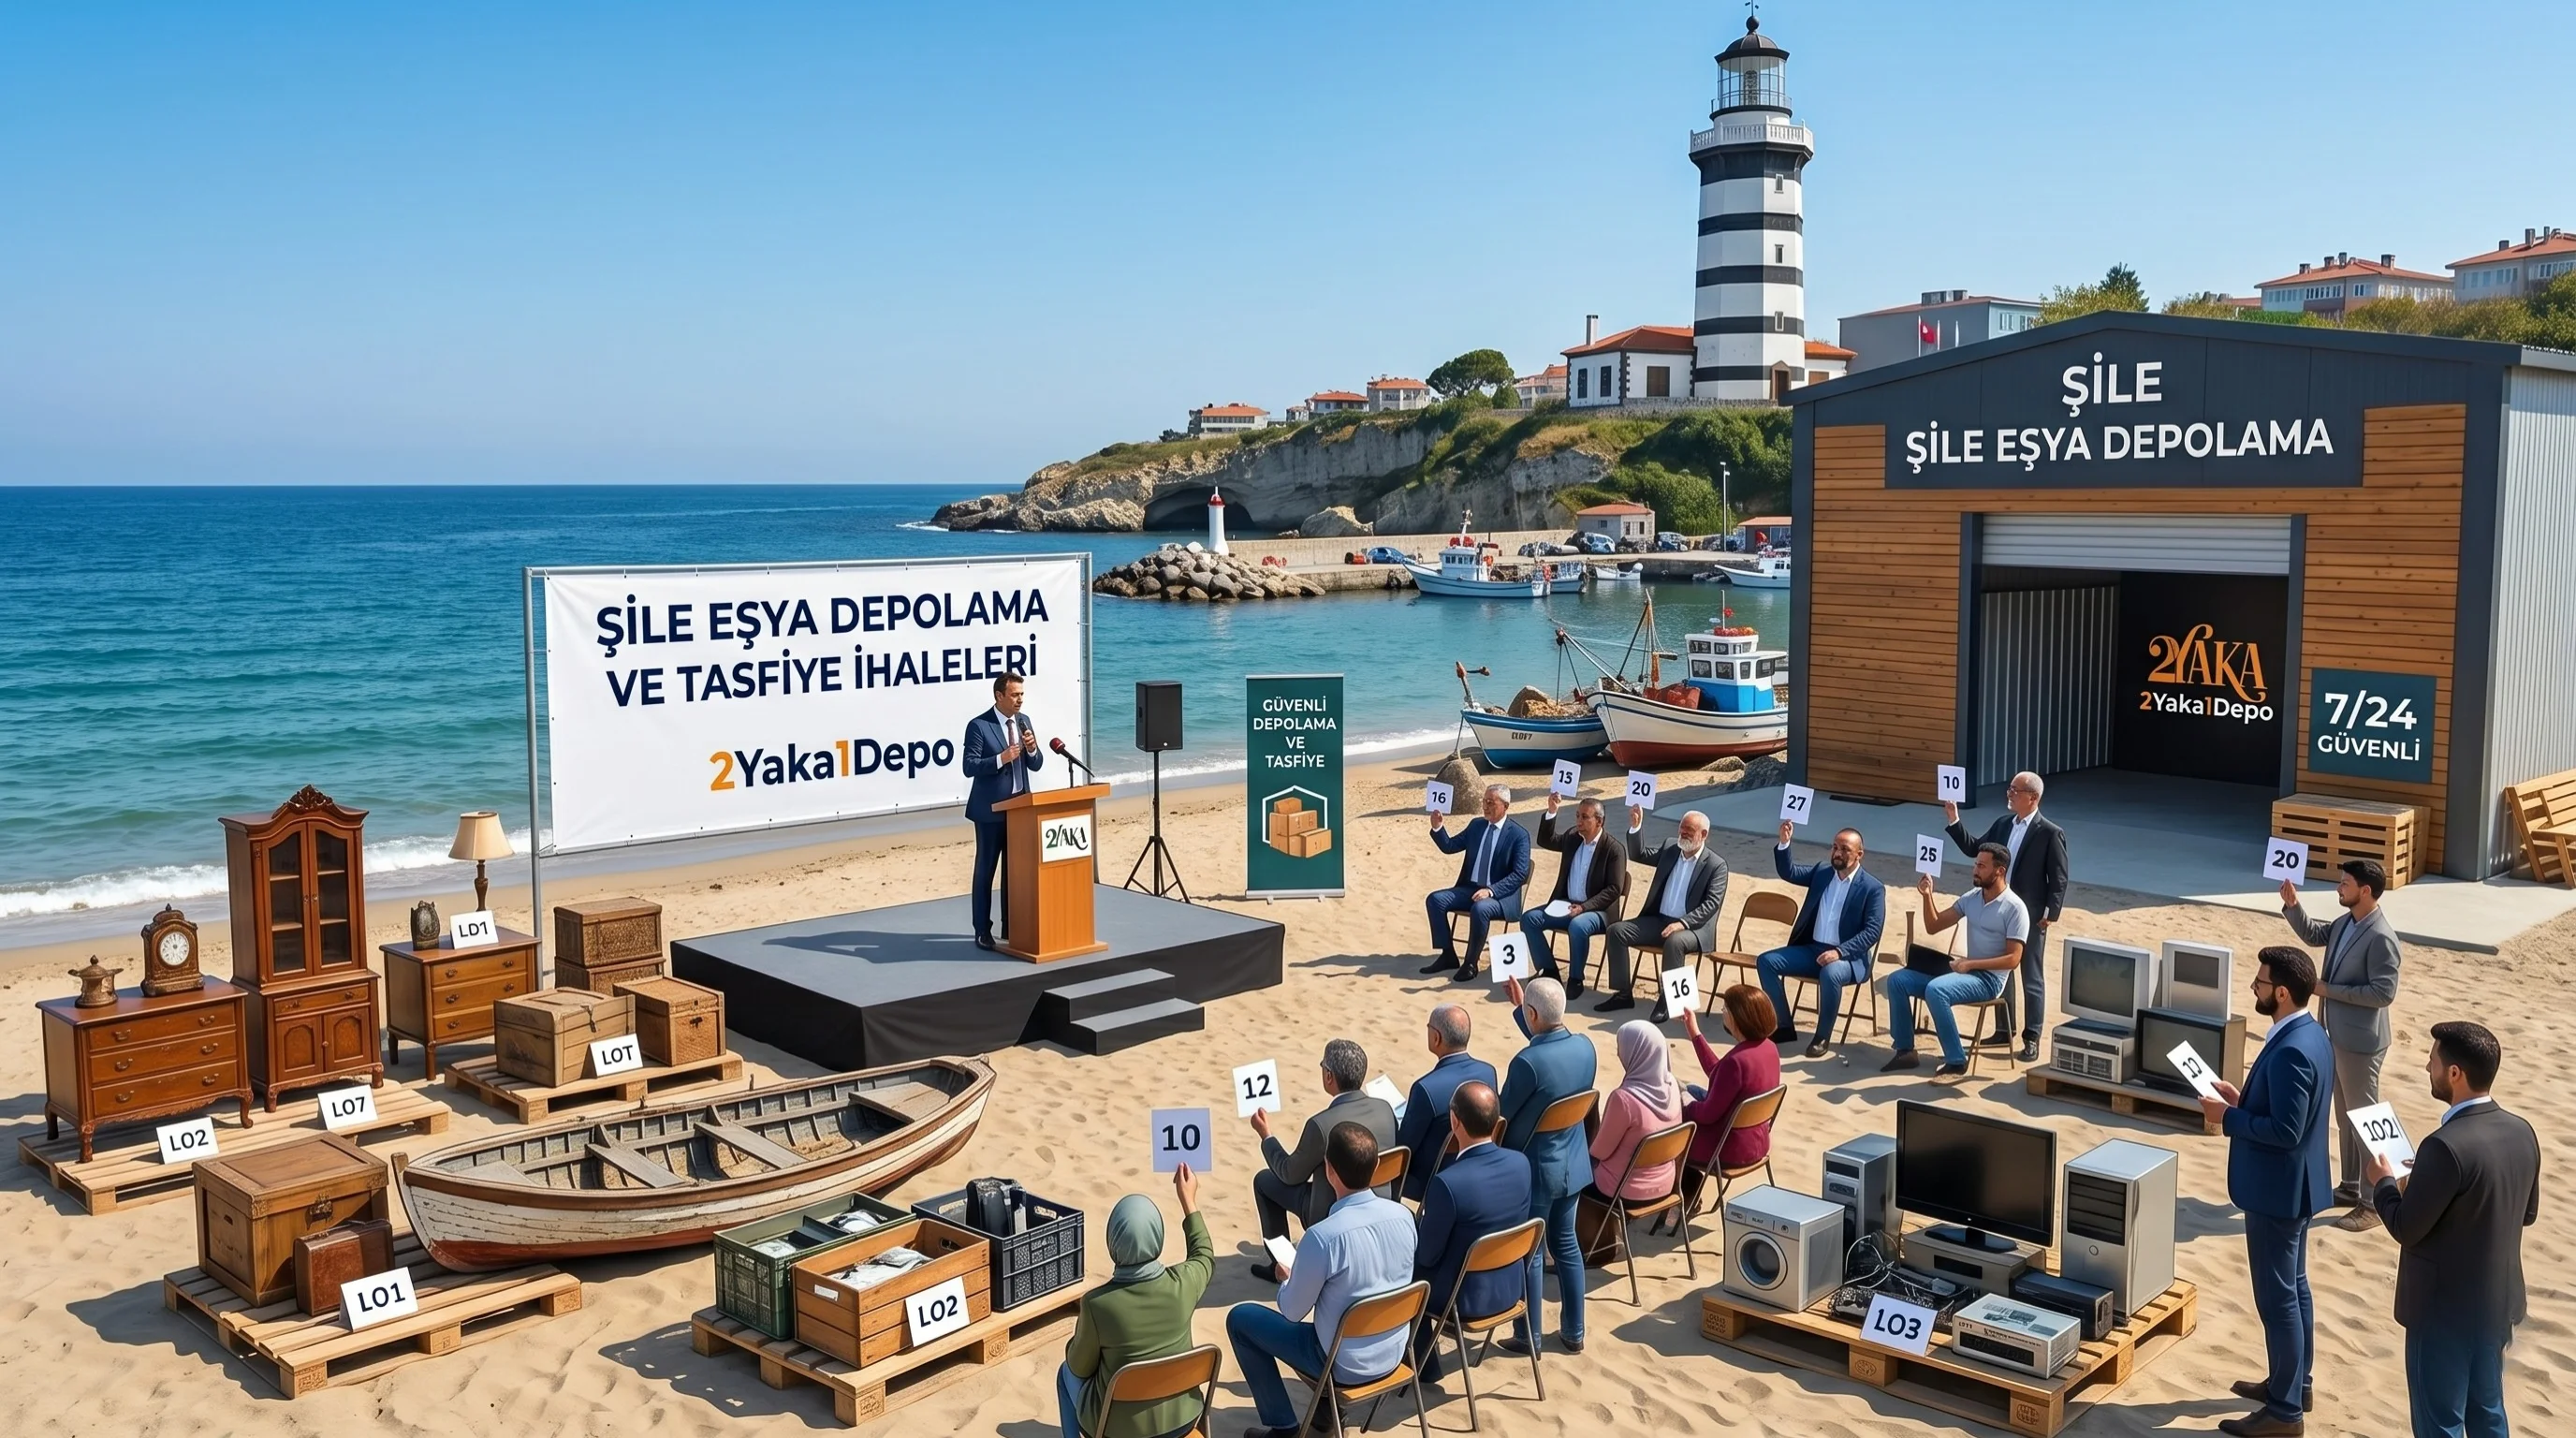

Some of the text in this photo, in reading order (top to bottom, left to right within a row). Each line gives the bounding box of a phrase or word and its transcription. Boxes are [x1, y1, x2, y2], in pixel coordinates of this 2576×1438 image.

[2062, 352, 2161, 417] ŞİLE
[1907, 418, 2334, 474] ŞİLE EŞYA DEPOLAMA
[597, 588, 1048, 657] ŞİLE EŞYA DEPOLAMA
[607, 633, 1037, 707] VE TASFİYE İHALELERİ
[1264, 696, 1325, 712] GÜVENLİ
[2140, 691, 2274, 725] 2Yaka1Depo
[2325, 689, 2418, 730] 7/24
[1254, 718, 1336, 729] DEPOLAMA
[1285, 737, 1305, 749] VE
[2318, 731, 2420, 760] GÜVENLİ
[710, 739, 954, 790] 2Yaka1Depo
[1266, 752, 1325, 768] TASFİYE
[1632, 781, 1650, 796] 20
[1944, 776, 1959, 789] 10
[1431, 791, 1446, 804] 16
[1786, 795, 1807, 811] 27
[1919, 844, 1937, 863] 25
[2273, 850, 2299, 869] 20
[1503, 945, 1515, 964] 3
[1672, 978, 1690, 998] 16
[1244, 1075, 1272, 1099] 12
[1163, 1124, 1200, 1151] 10
